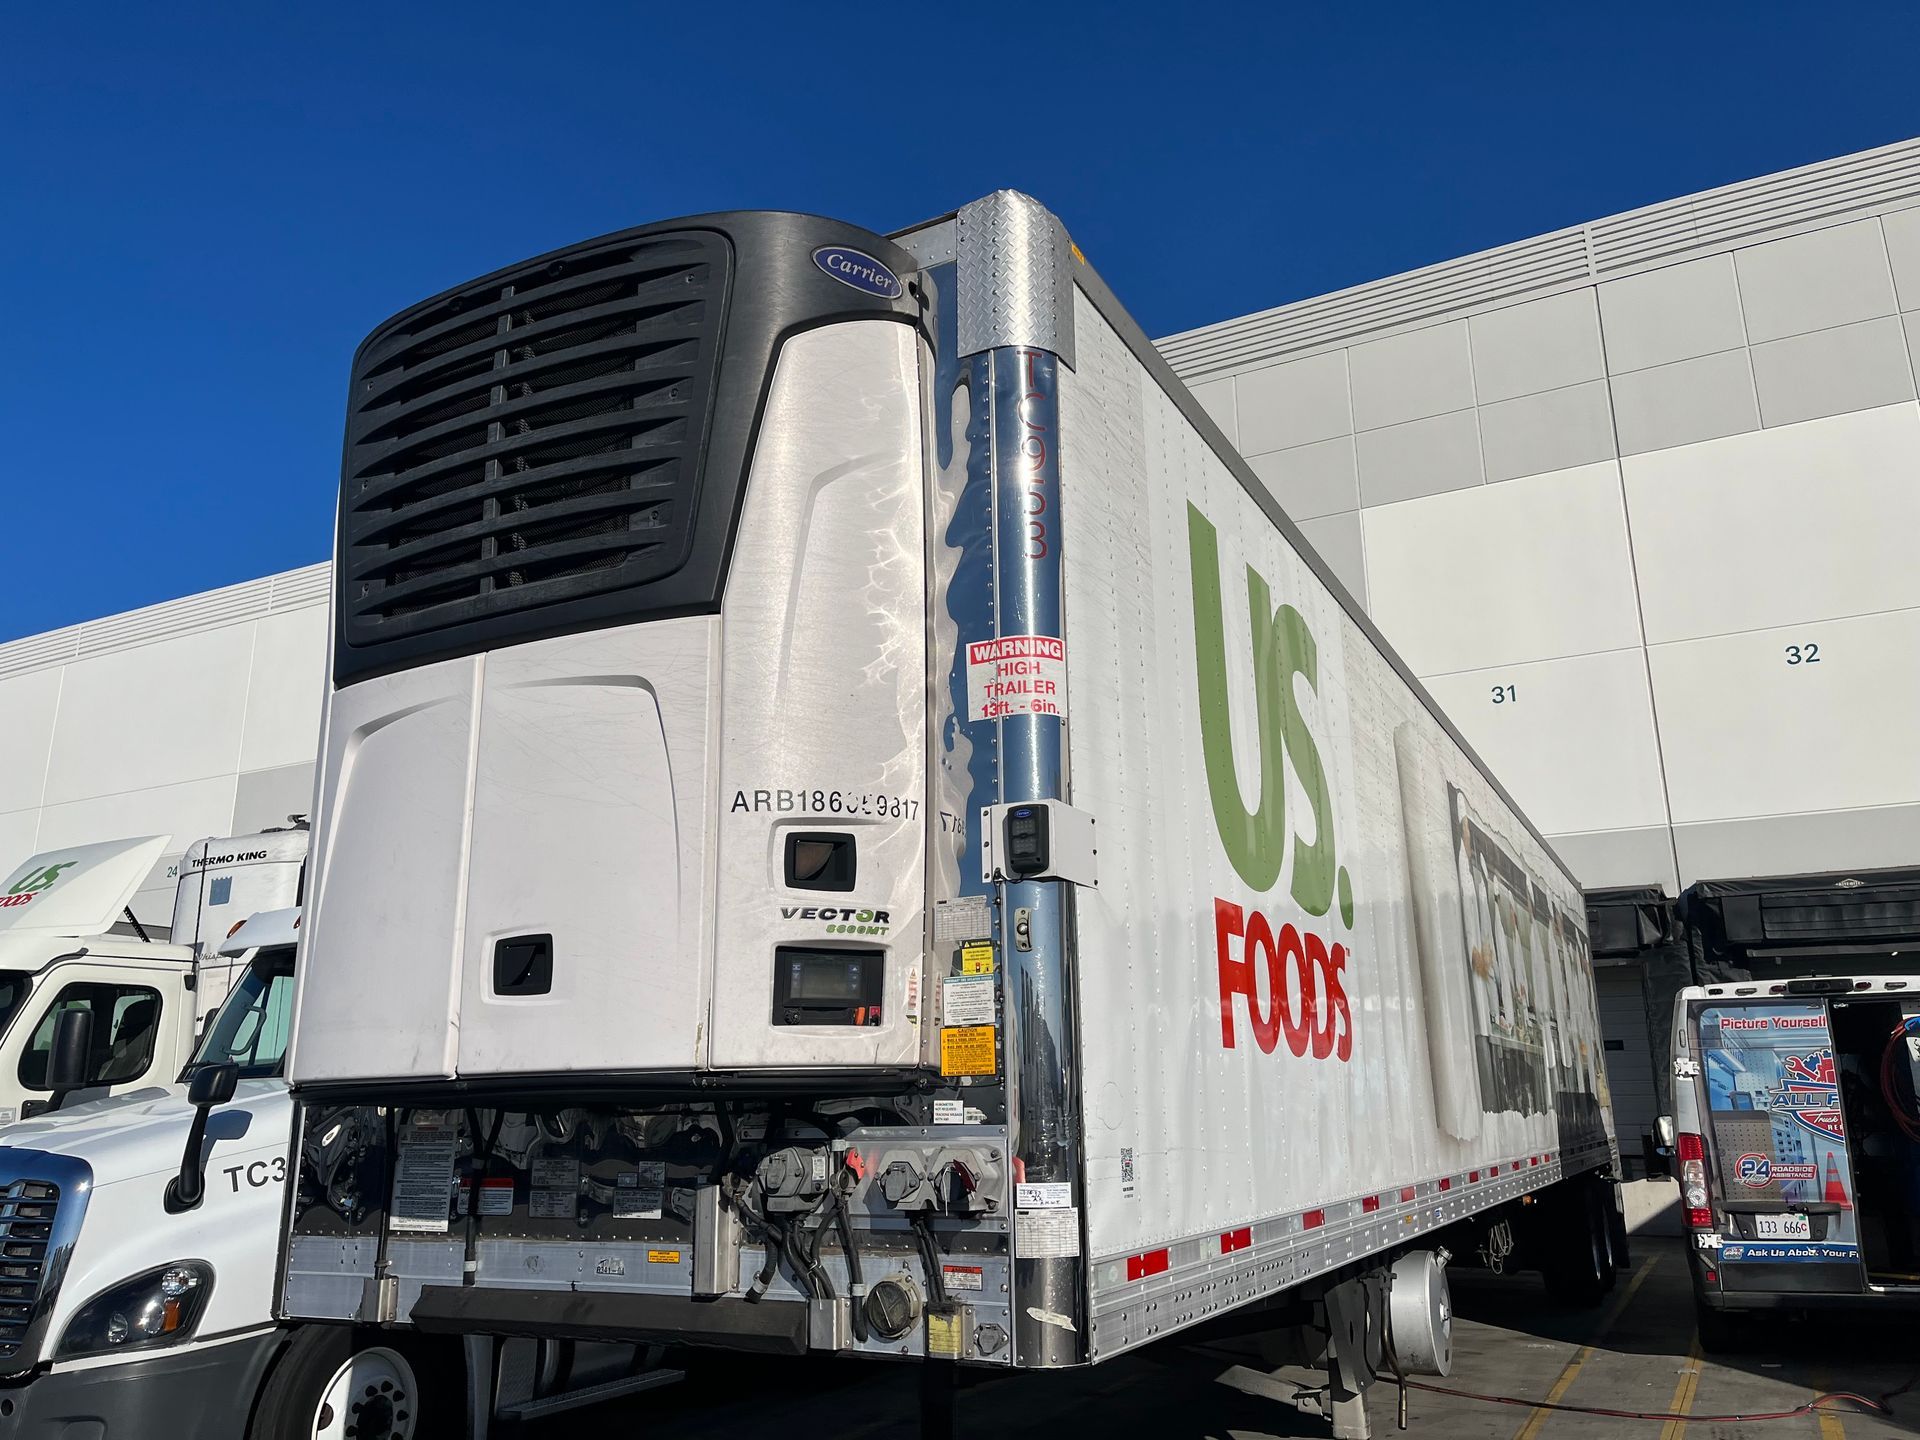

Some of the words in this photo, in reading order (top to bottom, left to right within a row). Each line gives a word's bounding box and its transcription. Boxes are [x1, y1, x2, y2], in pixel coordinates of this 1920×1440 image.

[827, 254, 892, 288] Carrier
[973, 640, 1061, 661] WARNING
[1784, 643, 1821, 665] 32
[997, 661, 1041, 677] HIGH
[984, 680, 1056, 698] TRAILER
[1491, 685, 1517, 704] 31
[1030, 699, 1060, 714] 6in.
[192, 854, 234, 868] THERMO
[237, 850, 267, 862] KING
[167, 865, 178, 878] 24
[780, 907, 890, 924] VECTOR
[1214, 896, 1353, 1063] FOODS
[1720, 1018, 1768, 1030] Picture
[1772, 1093, 1821, 1107] ALL
[1806, 1112, 1839, 1123] Truck
[1741, 1160, 1771, 1177] 24
[1760, 1221, 1777, 1233] 133
[1747, 1249, 1769, 1257] Ask
[1771, 1249, 1786, 1257] Us
[1822, 1249, 1847, 1258] Your
